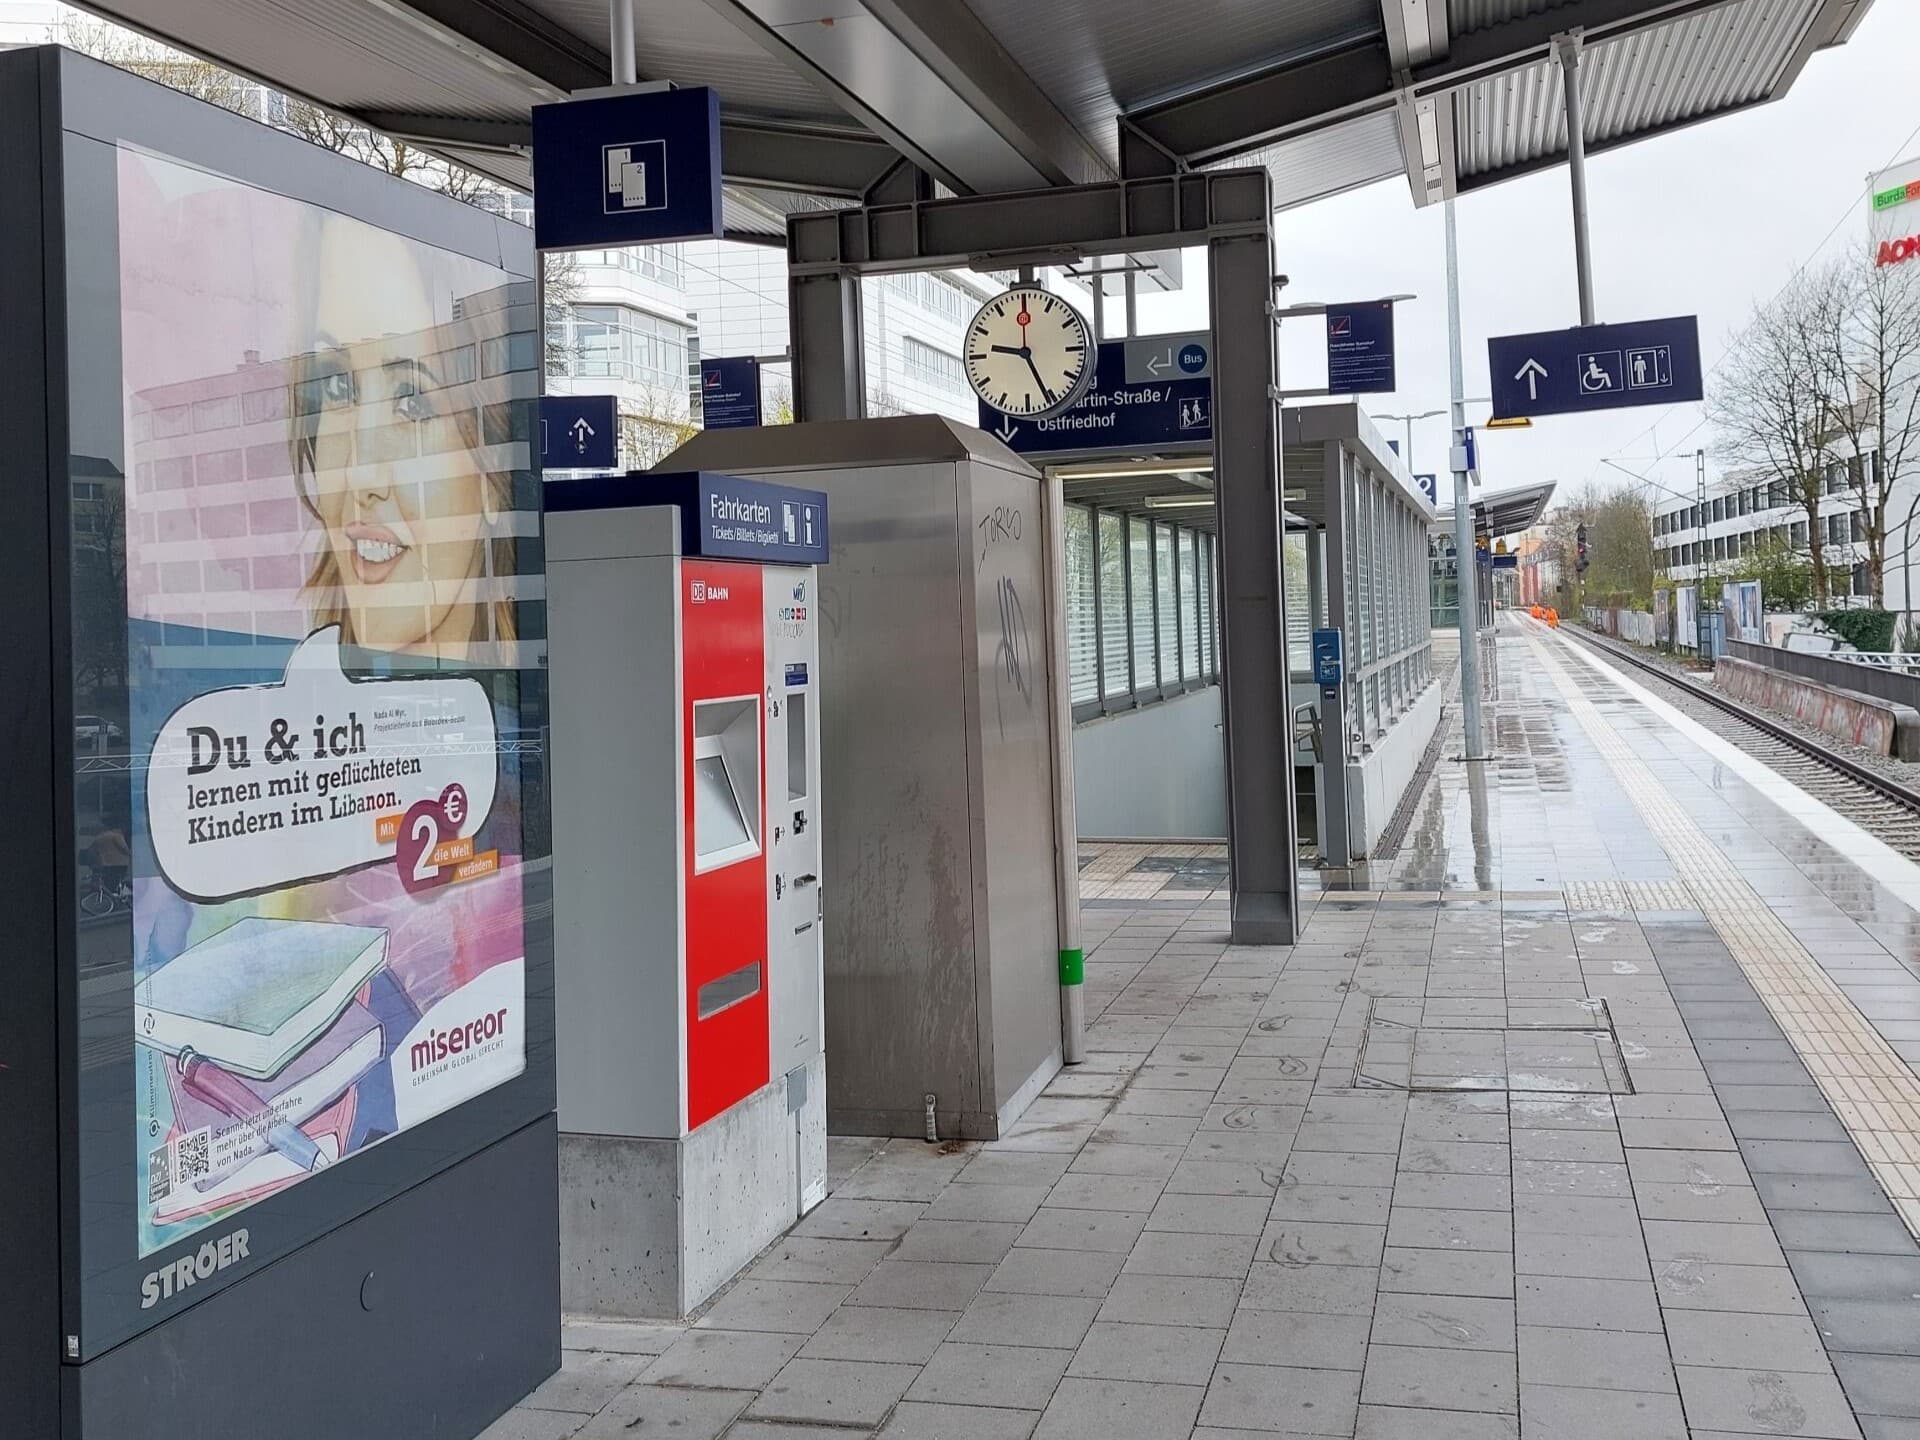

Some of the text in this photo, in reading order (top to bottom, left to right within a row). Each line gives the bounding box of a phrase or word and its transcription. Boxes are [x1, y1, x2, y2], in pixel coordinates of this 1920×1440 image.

[1184, 354, 1203, 364] Bus
[1072, 389, 1161, 409] artin-Straße
[1037, 413, 1117, 432] Ostfriedhof
[710, 493, 771, 525] Fahrkarten
[692, 582, 729, 602] DB BAHN
[186, 711, 367, 776] Du & ich
[187, 757, 422, 810] lernen mit geflüchteten
[187, 791, 402, 844] Kindern im Libanon.
[380, 821, 395, 837] Mit
[411, 790, 463, 882] 2 €
[434, 843, 470, 863] die Welt
[458, 857, 493, 878] verändern
[411, 1008, 507, 1073] misereor
[412, 1062, 449, 1087] GEMEINSAM
[451, 1052, 477, 1069] GLOBAL
[215, 1096, 303, 1139] Scanne jetzt und erfahre
[216, 1137, 237, 1153] mehr
[238, 1129, 255, 1145] über
[256, 1124, 267, 1138] die
[216, 1145, 255, 1167] von Nada.
[141, 1228, 250, 1309] STRÖER
